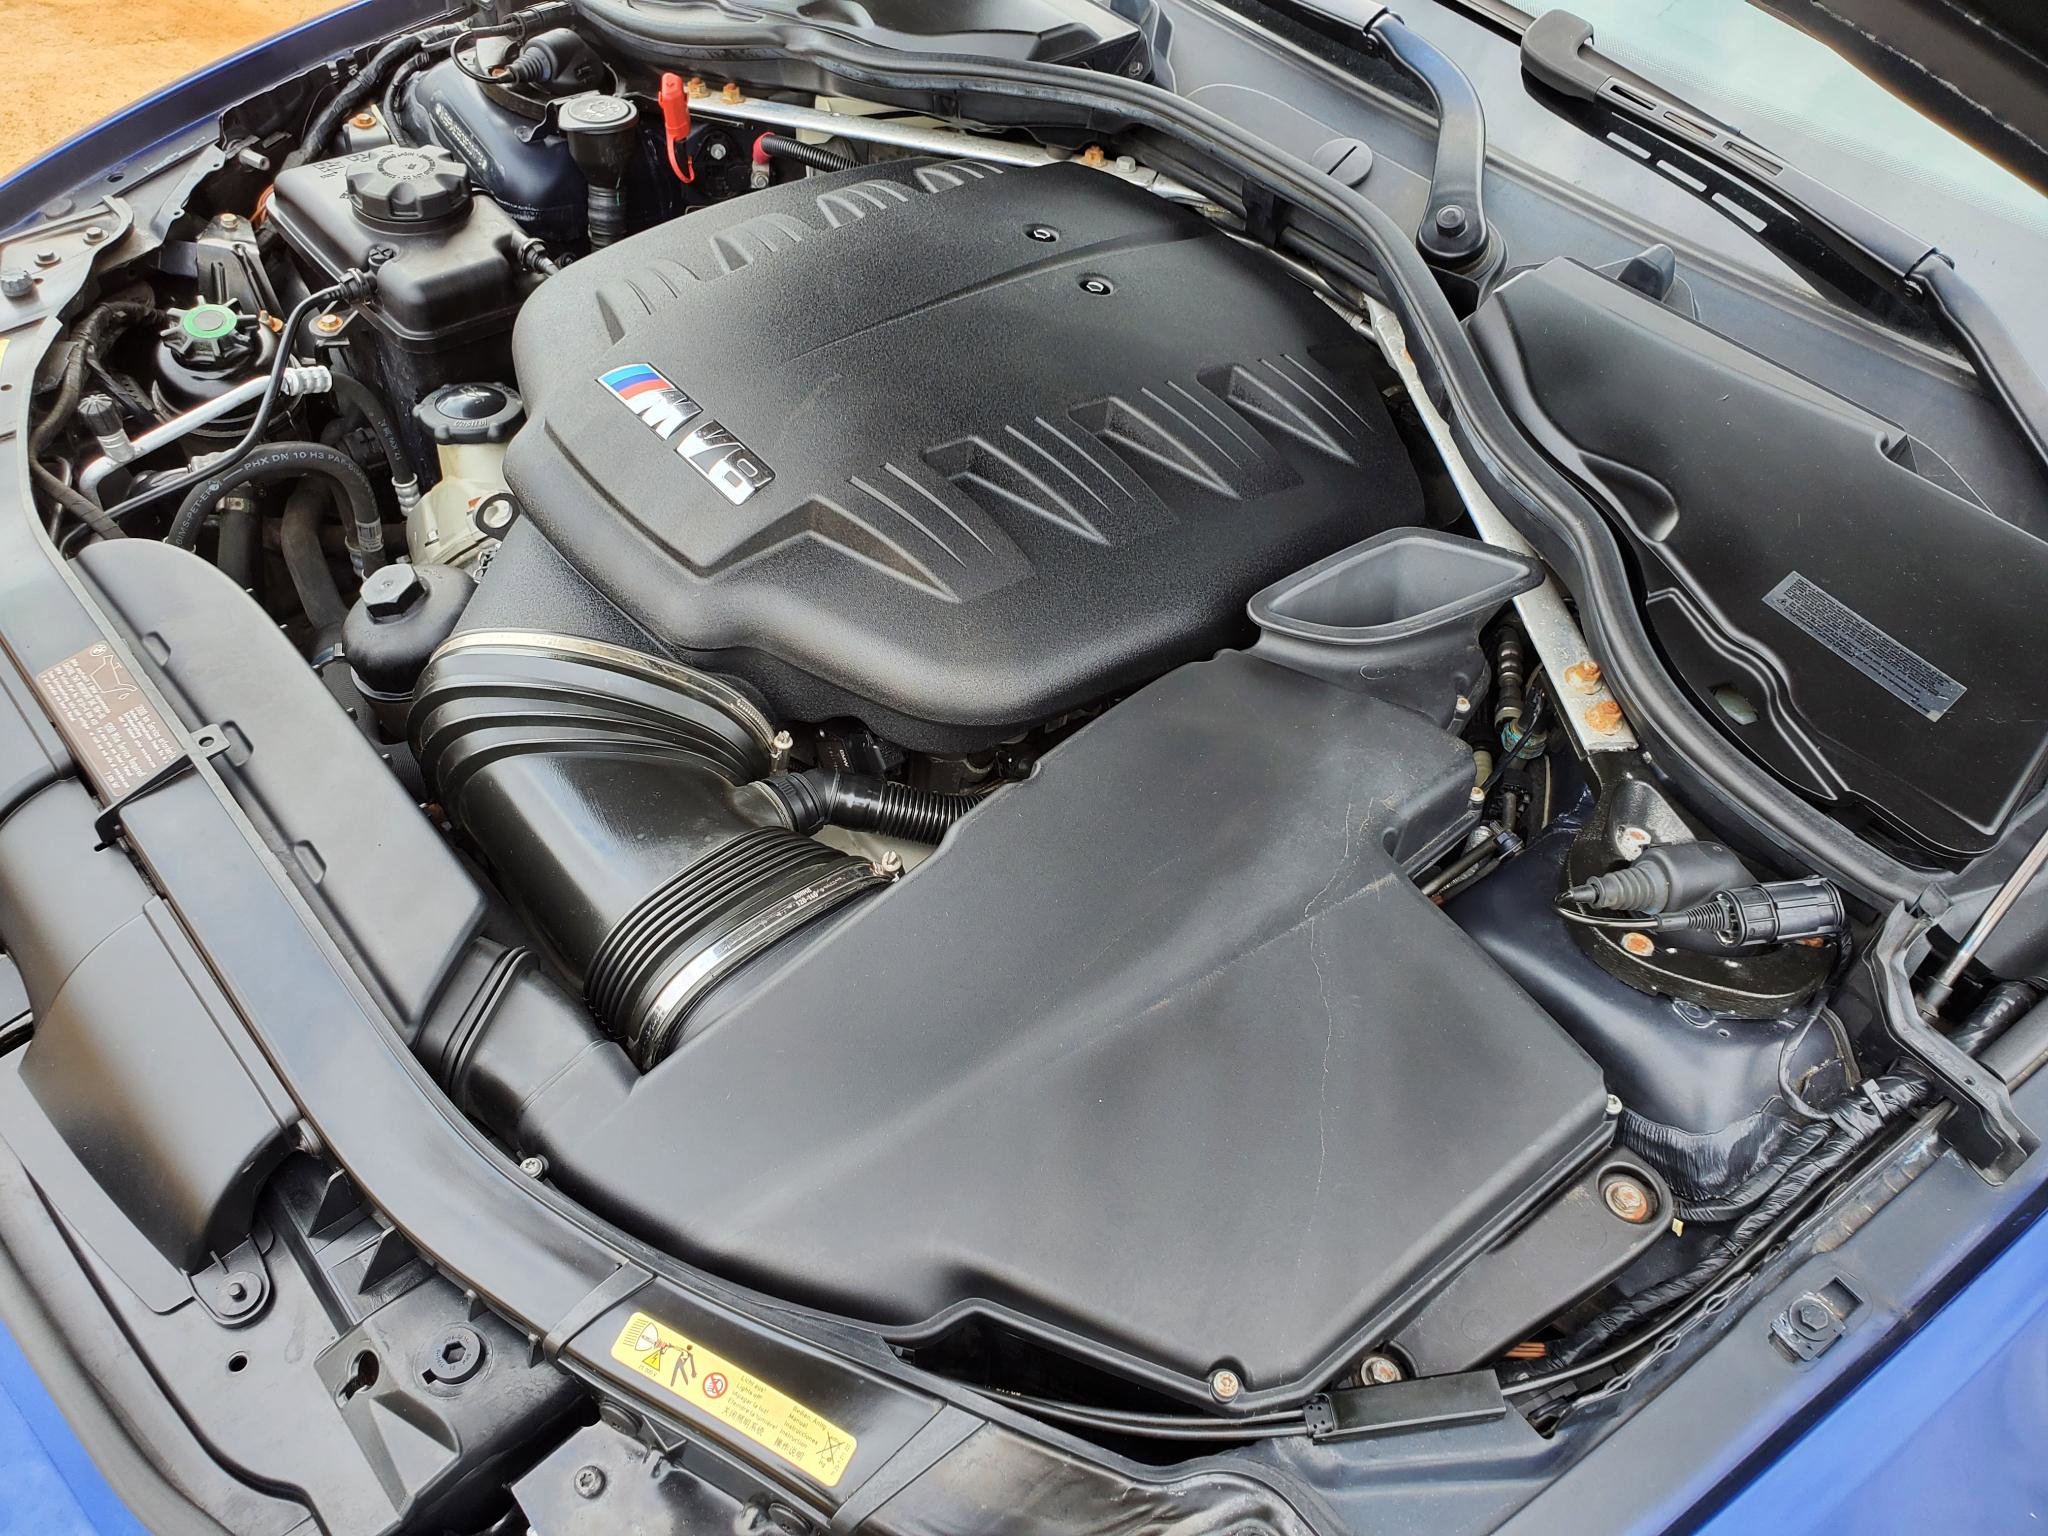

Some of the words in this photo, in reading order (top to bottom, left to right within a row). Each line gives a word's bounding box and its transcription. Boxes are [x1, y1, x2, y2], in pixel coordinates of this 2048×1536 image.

[244, 456, 269, 470] PHX
[272, 453, 290, 463] DN
[293, 451, 307, 459] 10
[310, 451, 325, 460] H3
[608, 372, 704, 441] M
[675, 418, 776, 505] V8
